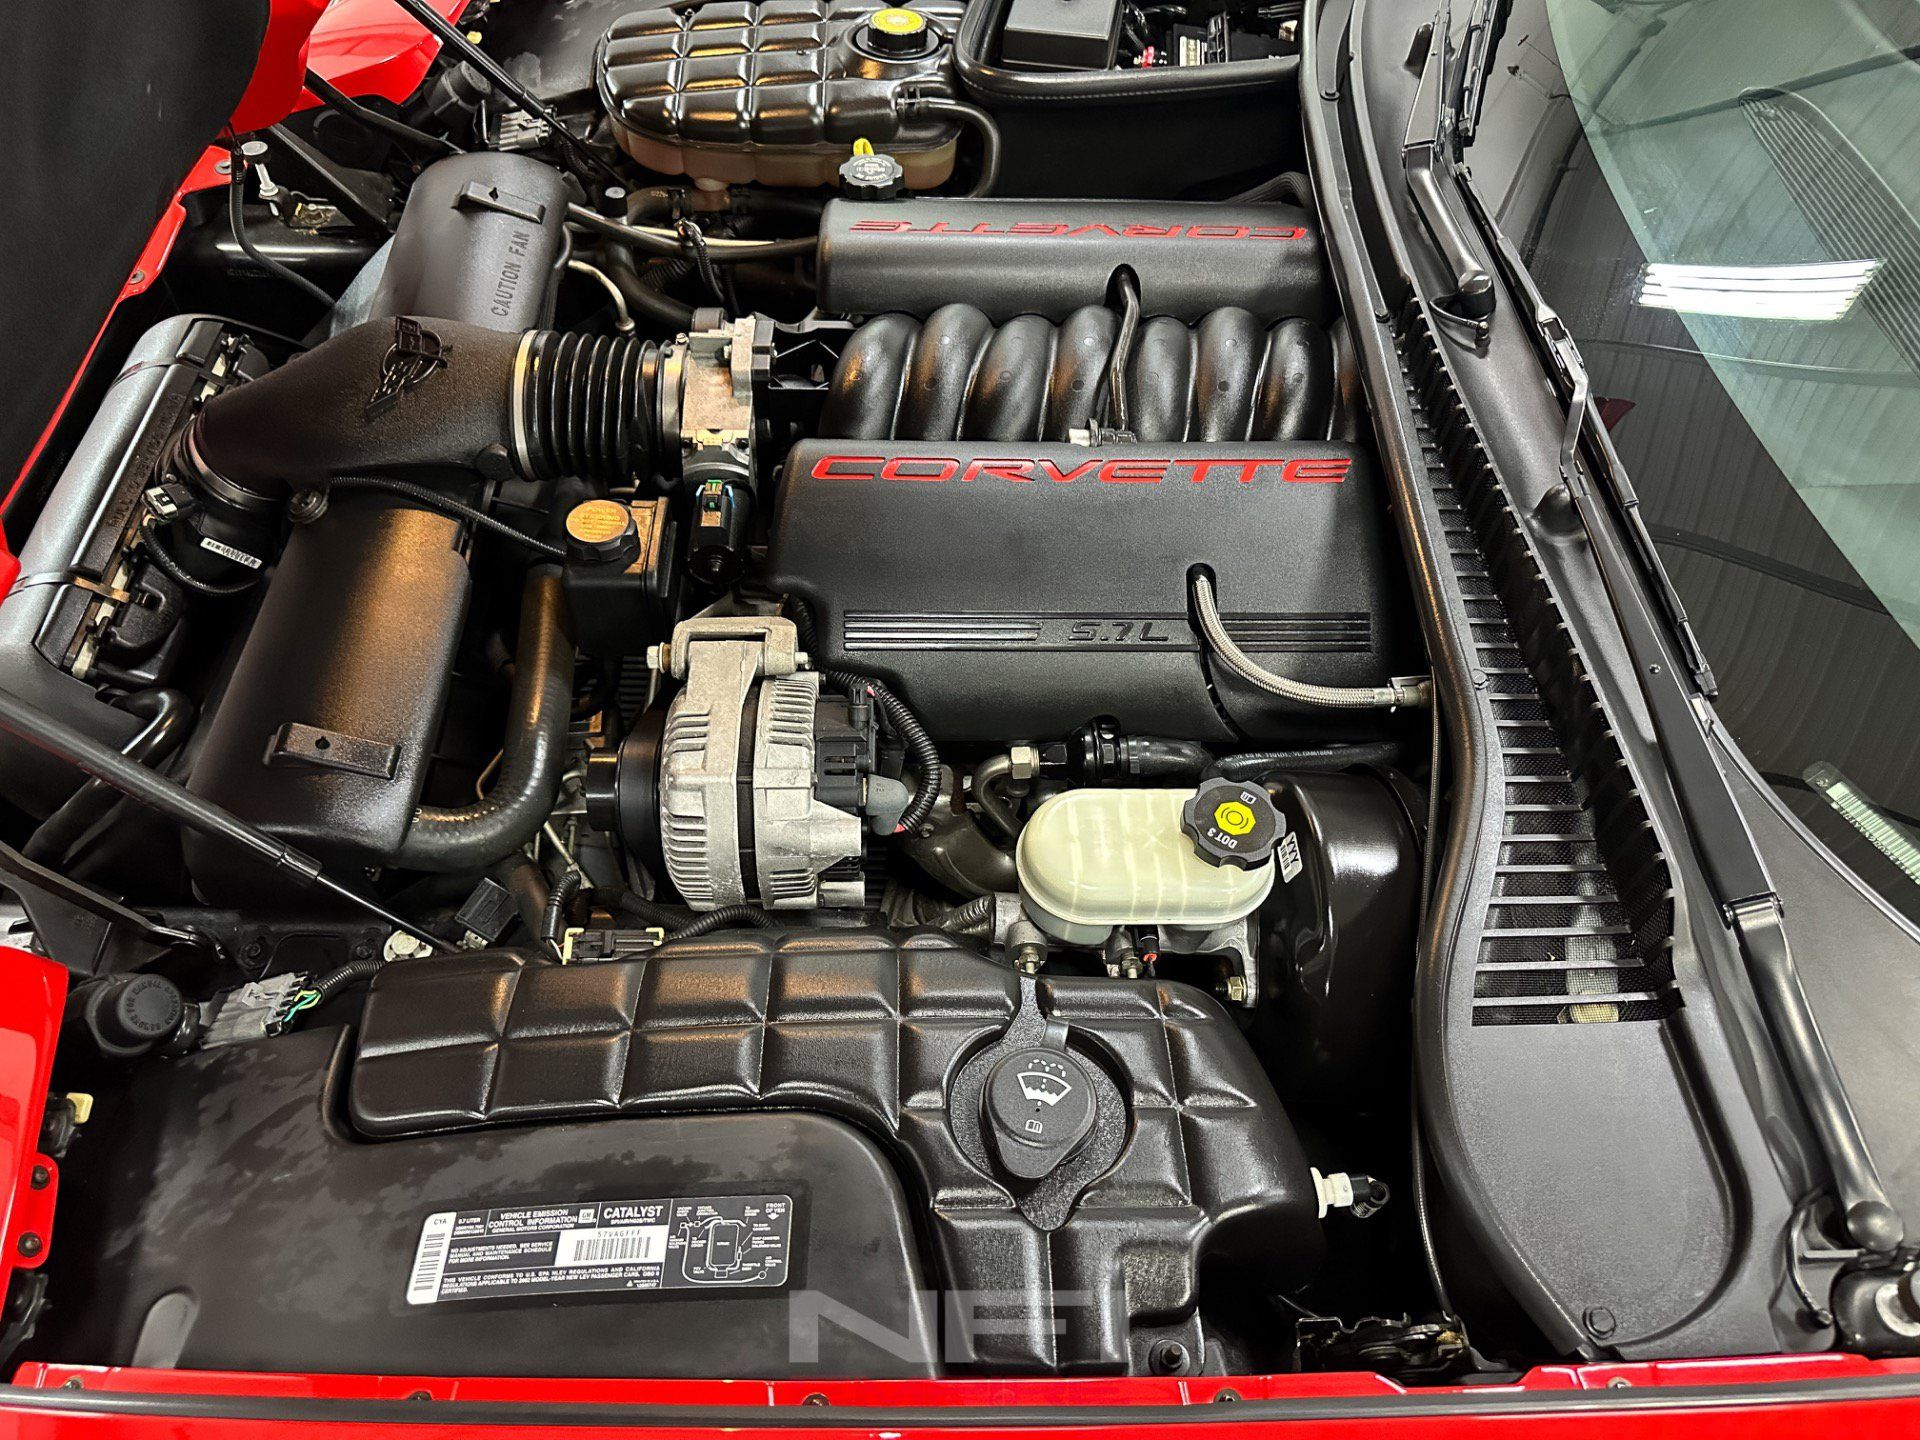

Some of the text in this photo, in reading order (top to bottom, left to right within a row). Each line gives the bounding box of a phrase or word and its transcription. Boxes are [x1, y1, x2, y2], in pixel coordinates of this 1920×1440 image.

[849, 220, 1308, 240] CORVETTE
[490, 230, 530, 317] CAUTION FAN
[811, 455, 1353, 484] CORVETTE
[1068, 621, 1169, 641] 5.7L
[1206, 827, 1238, 849] DOT 3
[500, 1208, 569, 1220] VEHICLE EMISSION
[604, 1205, 664, 1219] CATALYST
[488, 1219, 524, 1229] CONTROL
[526, 1216, 578, 1226] INFORMATION
[538, 1223, 575, 1231] CORPORATION
